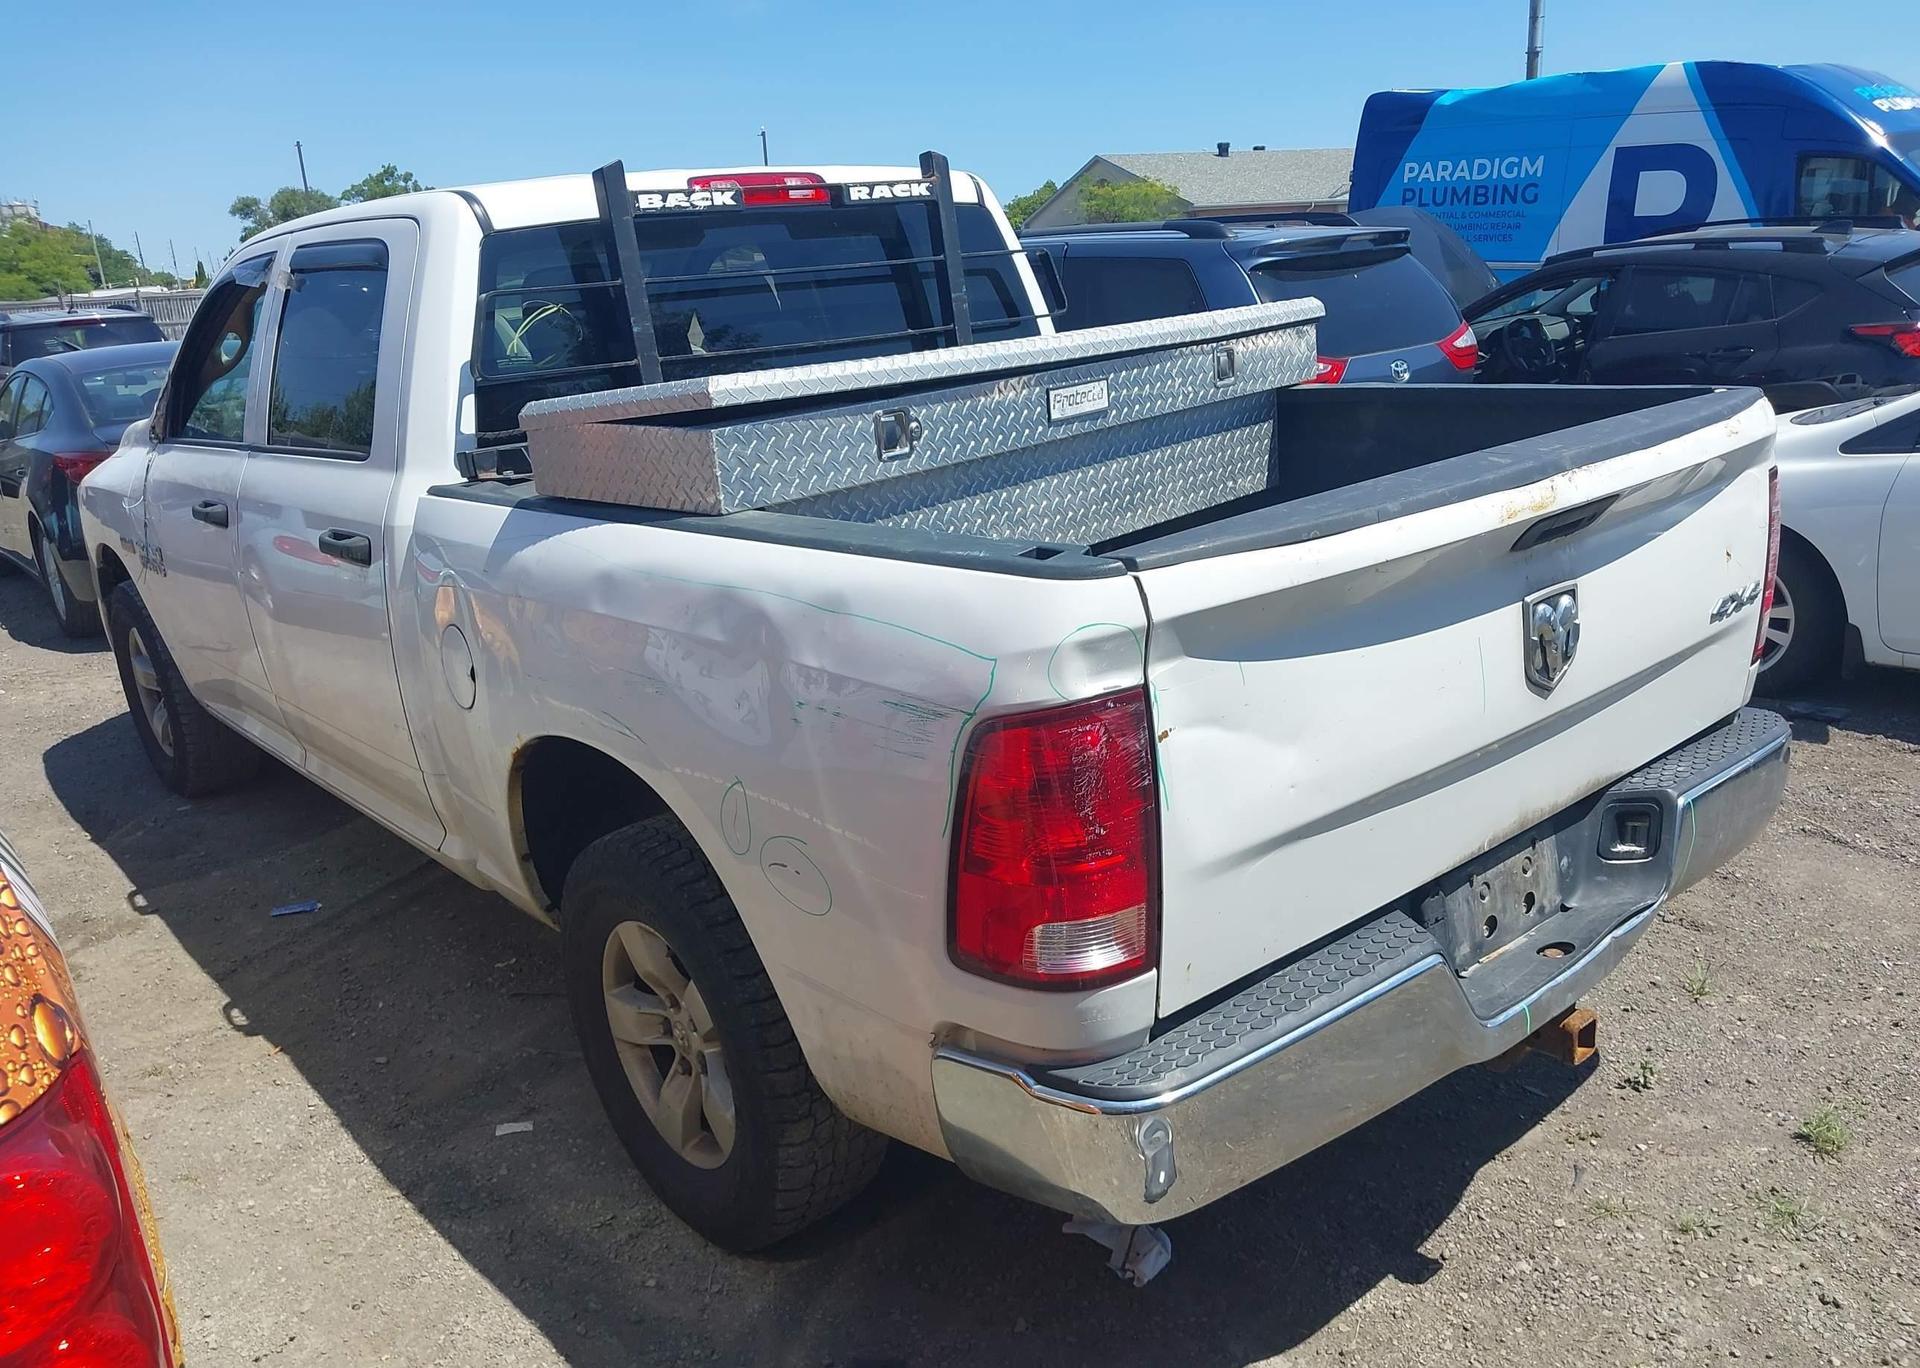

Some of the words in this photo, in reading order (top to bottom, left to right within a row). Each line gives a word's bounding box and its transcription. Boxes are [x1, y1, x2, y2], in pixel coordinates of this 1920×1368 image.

[1403, 155, 1545, 183] PARADIGM
[637, 191, 737, 209] BACK
[849, 182, 931, 201] RACK
[1401, 182, 1540, 208] PLUMBING
[1468, 209, 1527, 219] COMMERCIAL
[1490, 222, 1521, 231] REPAIR
[1473, 233, 1513, 242] SERVICES
